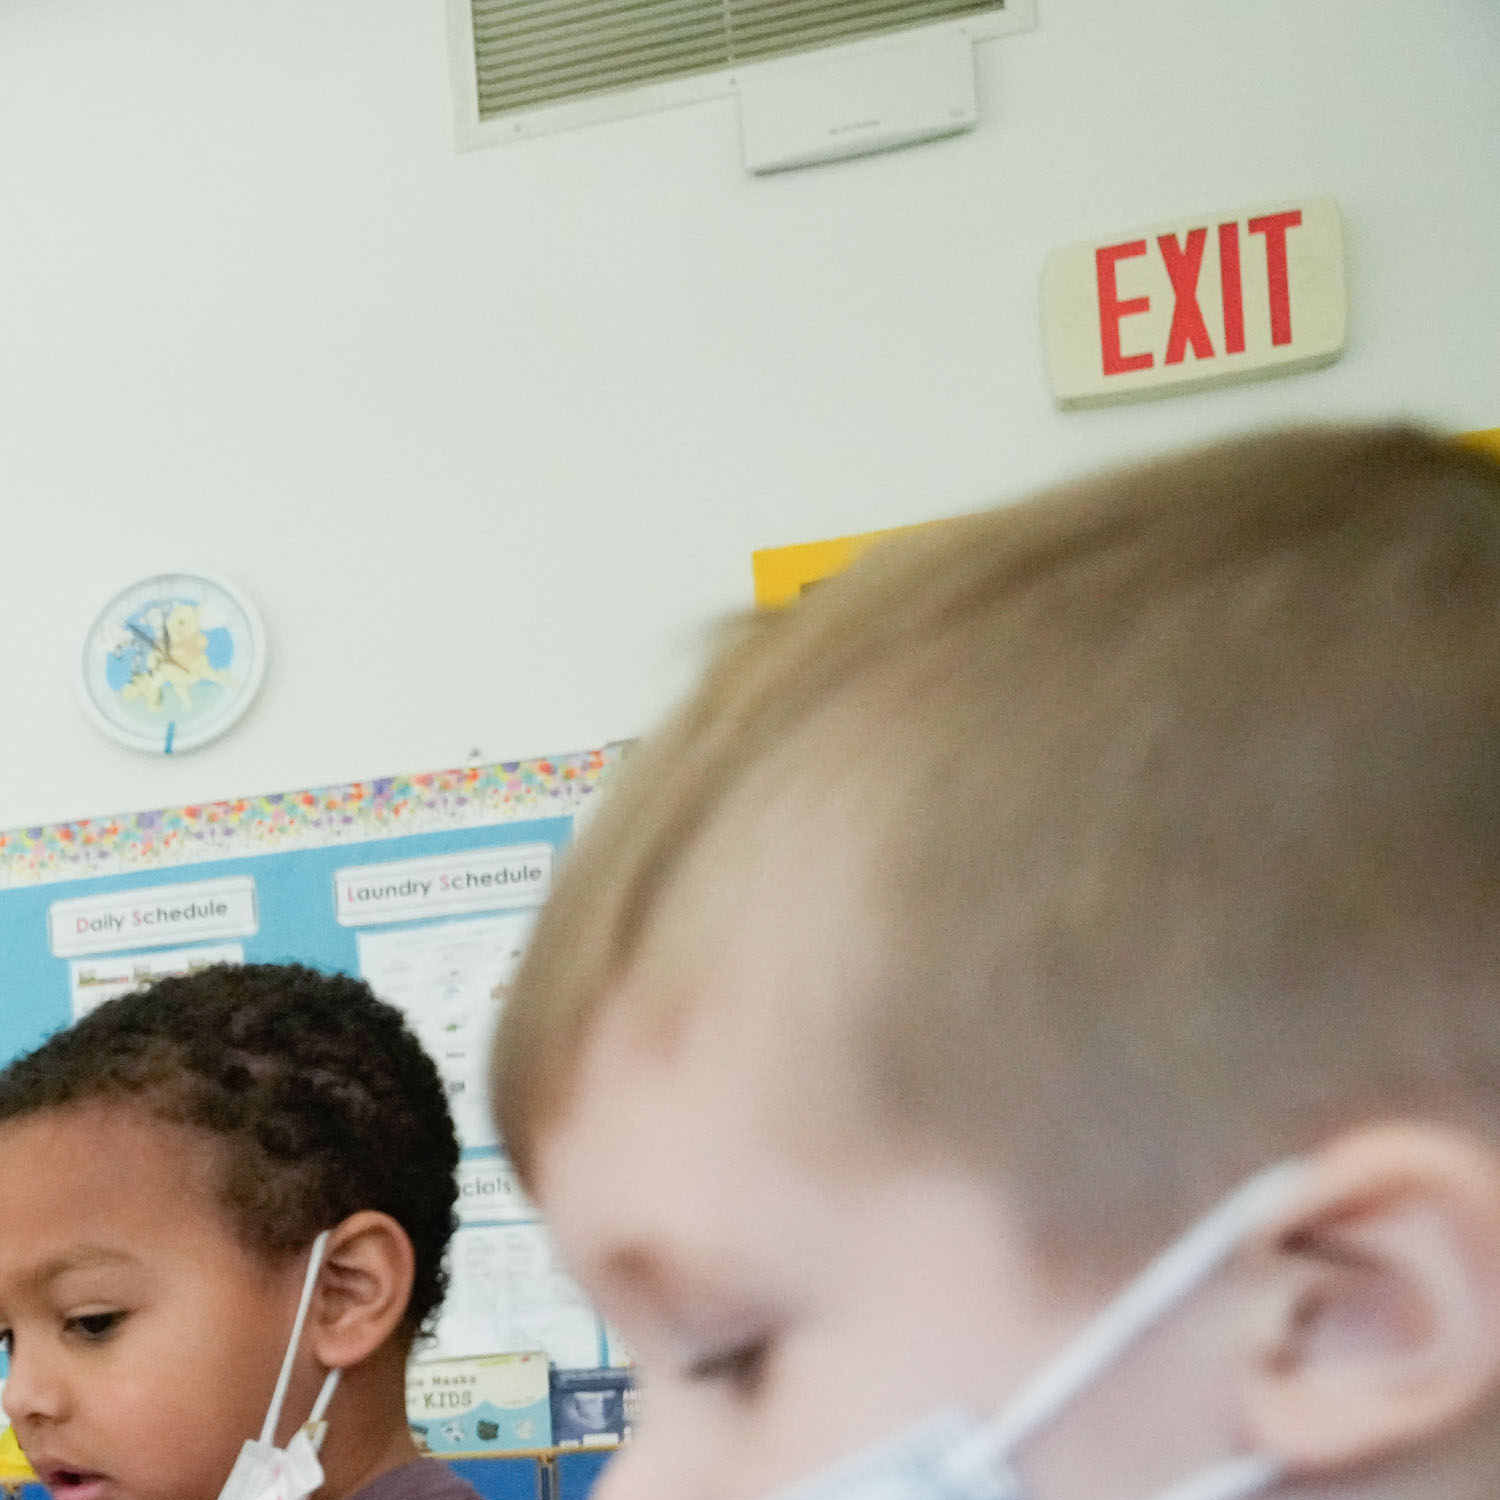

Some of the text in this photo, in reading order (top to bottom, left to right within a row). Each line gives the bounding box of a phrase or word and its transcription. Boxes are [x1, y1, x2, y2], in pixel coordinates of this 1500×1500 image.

[1094, 209, 1303, 377] EXIT
[347, 865, 543, 903] Laundry Schedule
[75, 900, 229, 935] Daily Schedule
[460, 1177, 512, 1198] cials
